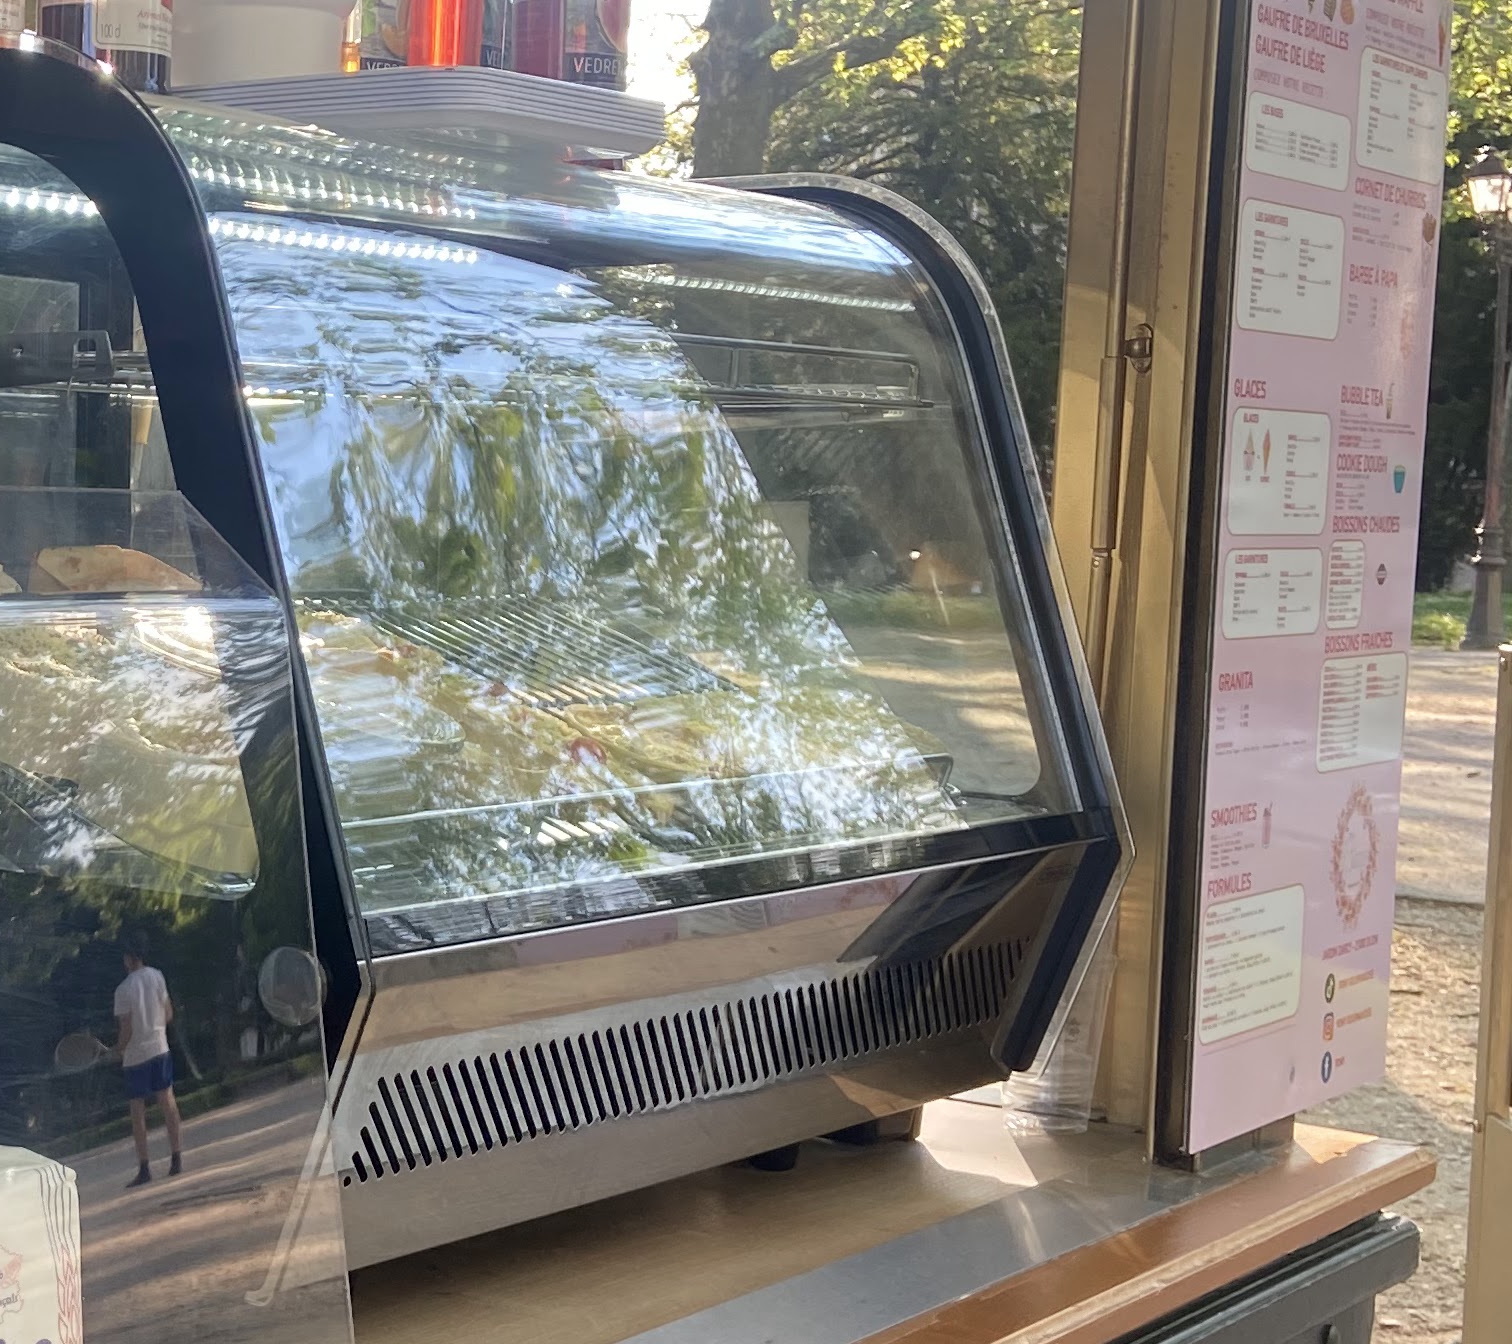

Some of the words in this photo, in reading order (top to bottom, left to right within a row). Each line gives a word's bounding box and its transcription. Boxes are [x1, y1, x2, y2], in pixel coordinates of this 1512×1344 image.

[1258, 3, 1291, 32] GAUFRE
[1292, 14, 1303, 36] DE
[1255, 34, 1289, 62] GAUFRE
[1290, 44, 1301, 66] DE
[1355, 177, 1385, 201] CORNET
[1384, 183, 1395, 203] DE
[1234, 378, 1267, 399] GLACES
[1340, 385, 1370, 406] BUBBLE
[1370, 388, 1384, 407] TEA
[1336, 453, 1362, 472] COOKIE
[1363, 454, 1388, 473] DOUGH
[1332, 515, 1368, 533] BOISSONS
[1369, 515, 1401, 533] CHAUDES
[1324, 633, 1360, 654] BOISSONS
[1218, 671, 1254, 692] GRANITA
[1210, 802, 1257, 828] SMOOTHIES
[1207, 872, 1251, 898] FORMULES
